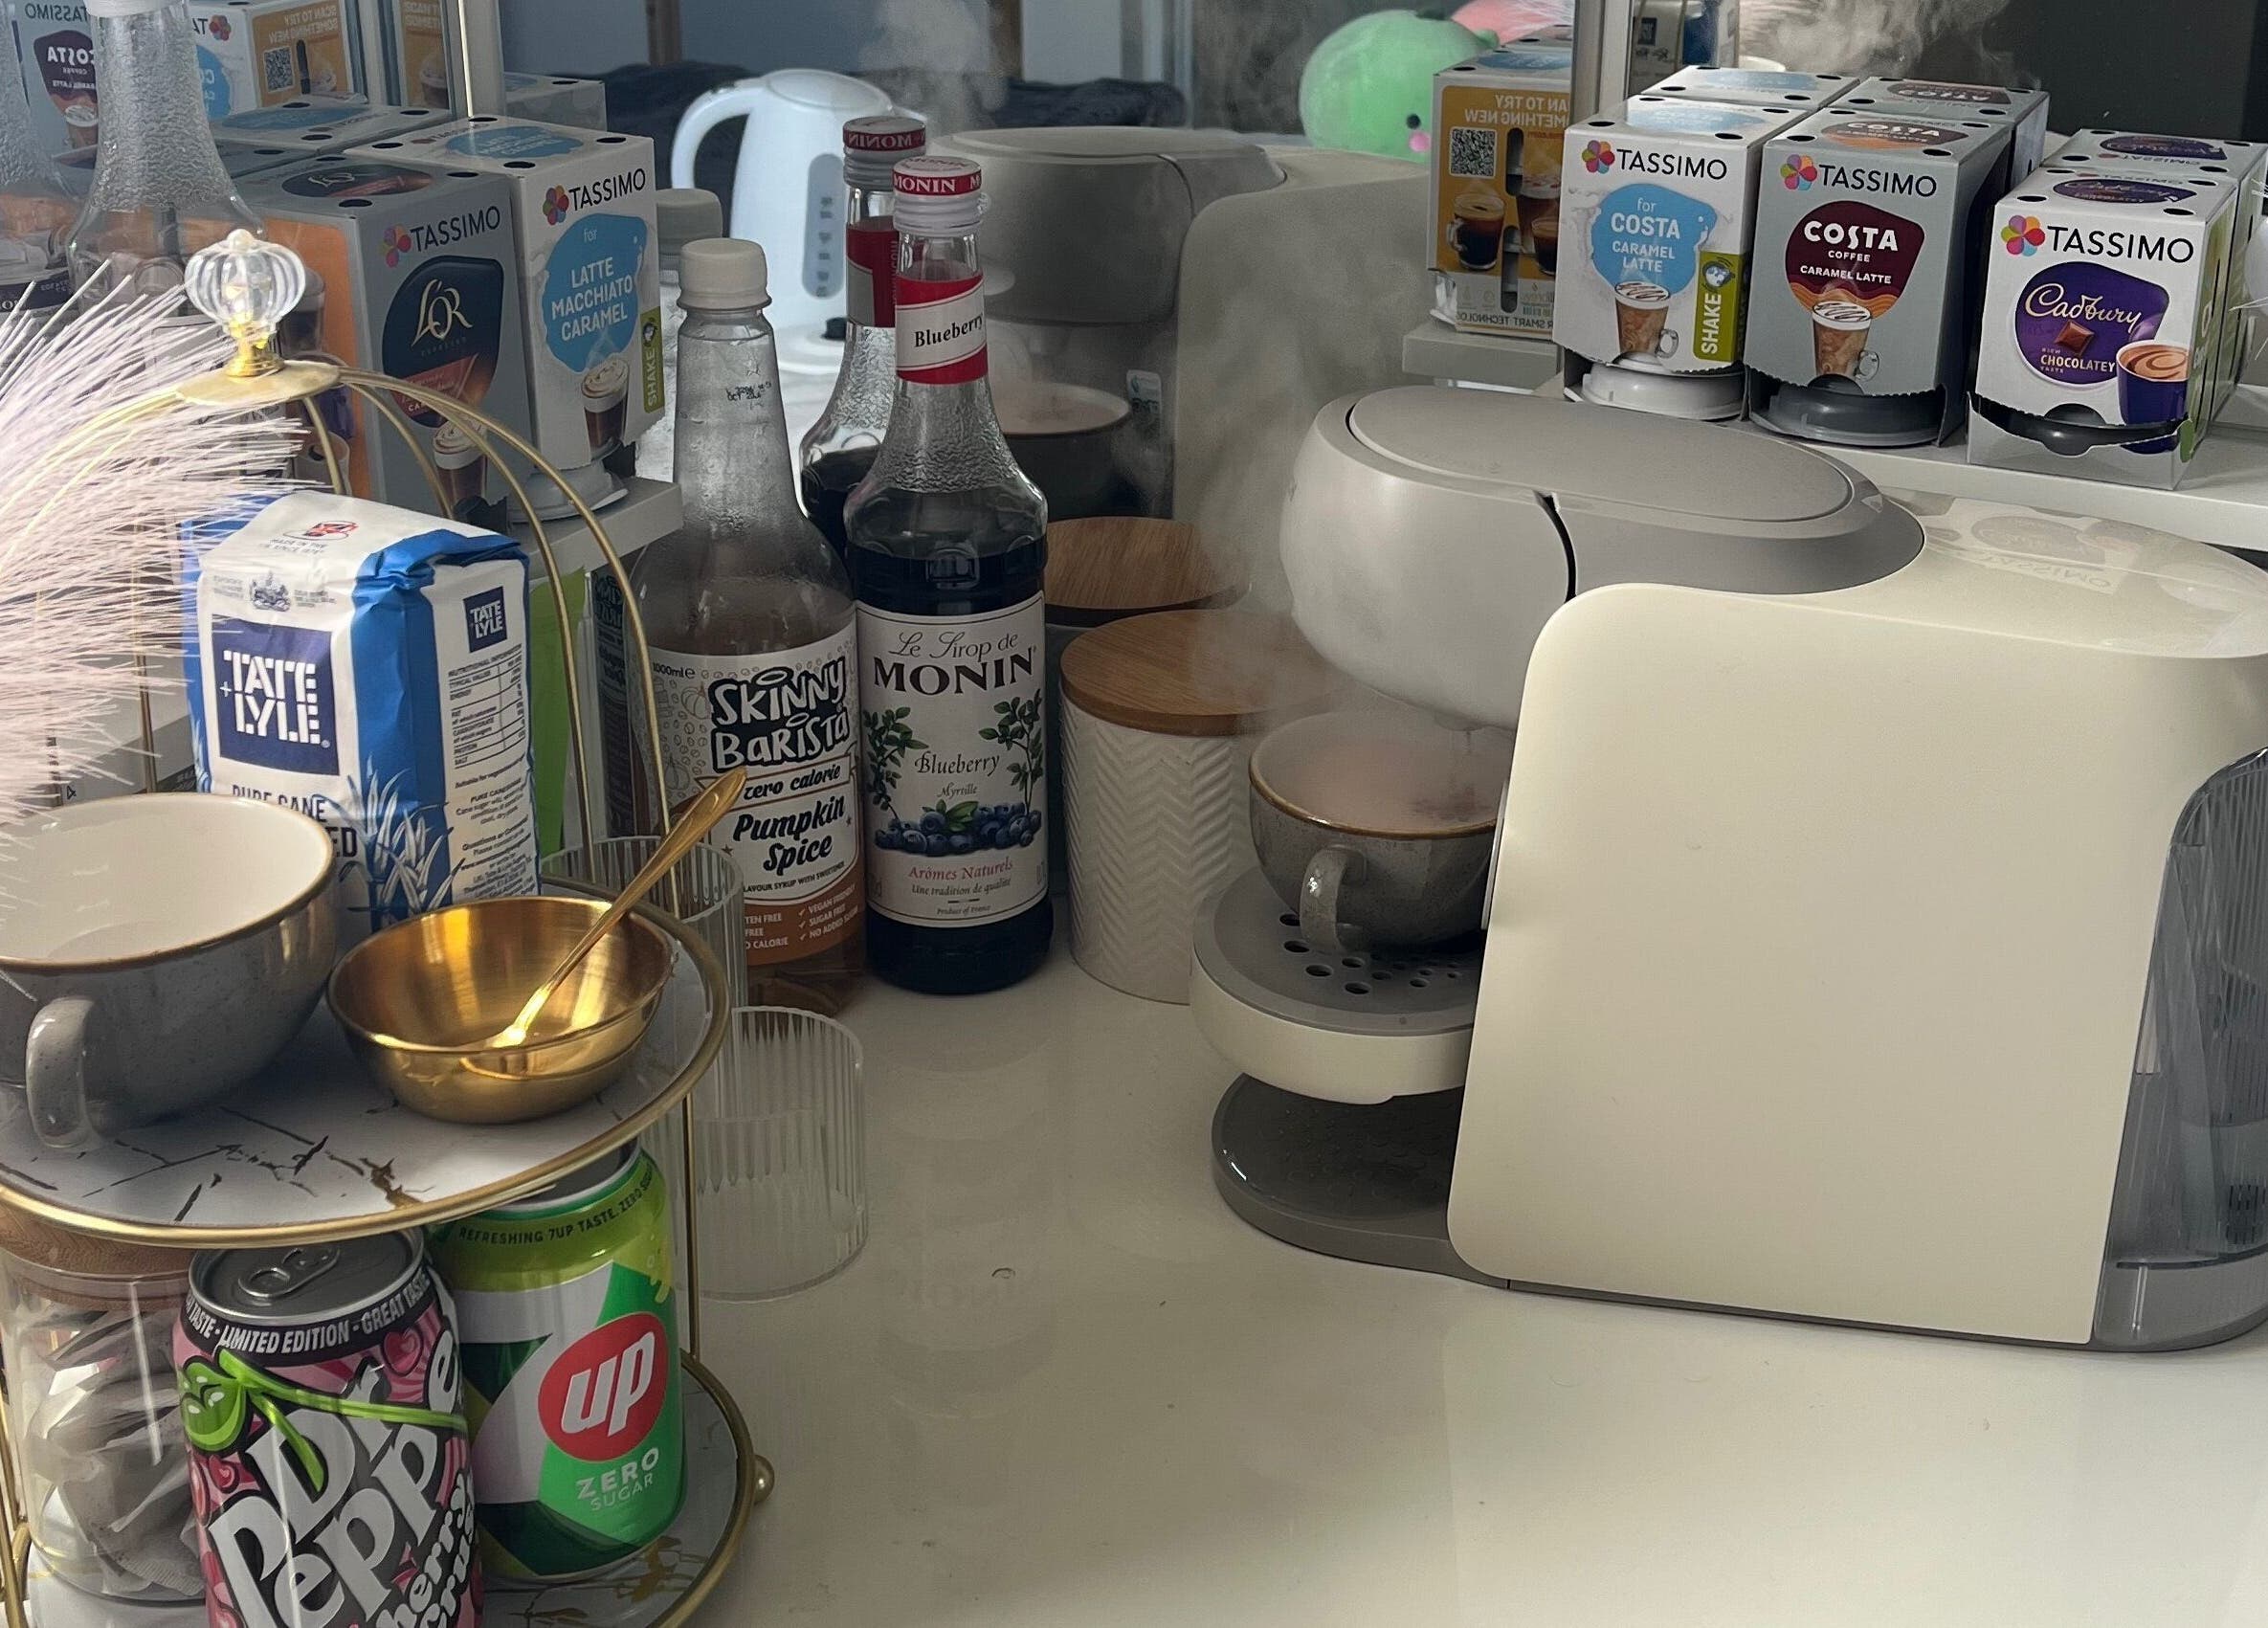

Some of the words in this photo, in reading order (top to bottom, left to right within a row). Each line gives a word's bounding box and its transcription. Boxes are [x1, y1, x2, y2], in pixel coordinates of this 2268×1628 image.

[1847, 122, 1940, 137] COSTA
[1616, 148, 1727, 180] TASSIMO
[568, 167, 646, 212] TASSIMO
[894, 176, 955, 192] MONIN
[1818, 164, 1938, 197] TASSIMO
[1637, 197, 1656, 213] for
[410, 206, 500, 253] TASSIMO
[584, 228, 598, 243] for
[1611, 212, 1680, 239] COSTA
[1804, 221, 1899, 252] COSTA
[1612, 240, 1676, 259] CARAMEL
[1828, 250, 1871, 262] COFFEE
[2047, 225, 2194, 263] TASSIMO
[570, 256, 614, 288] LATTE
[1623, 257, 1663, 273] LATTE
[1800, 265, 1855, 281] CARAMEL
[1856, 271, 1892, 284] LATTE
[551, 275, 634, 320] MACCHIATO
[2025, 283, 2142, 334] Cadbury
[561, 302, 628, 342] CARAMEL
[915, 314, 983, 347] Blueberry
[1701, 293, 1723, 355] SHAKE
[646, 347, 658, 407] SHAKE
[2040, 354, 2116, 373] CHOCOLATEY
[469, 599, 502, 624] TATE
[474, 615, 504, 640] LYLE
[888, 631, 923, 658] Le
[928, 631, 992, 663] Sirop
[997, 633, 1018, 650] de
[223, 649, 318, 703] TATE
[873, 646, 1033, 696] MONIN
[234, 692, 322, 746] LYLE
[914, 750, 1001, 777] Blueberry
[744, 779, 784, 800] zero
[789, 765, 841, 790] calorie
[937, 782, 979, 798] Myrtille
[733, 795, 846, 842] Pumpkin
[763, 835, 833, 876] Spice
[961, 856, 1013, 881] Naturels
[743, 882, 773, 893] LAVOUR
[911, 883, 930, 896] Une
[930, 883, 971, 899] tradition
[972, 881, 983, 893] de
[745, 914, 763, 925] TEN
[763, 912, 783, 923] FREE
[809, 911, 834, 927] SUGAR
[809, 926, 822, 939] NO
[752, 936, 789, 950] CALORIE
[458, 1226, 544, 1244] REFRESHING
[547, 1221, 574, 1241] 7UP
[219, 1324, 279, 1354] LIMITED
[280, 1321, 350, 1354] EDITION
[360, 1298, 406, 1335] GREAT
[575, 1446, 659, 1501] ZERO
[589, 1472, 654, 1511] SUGAR
